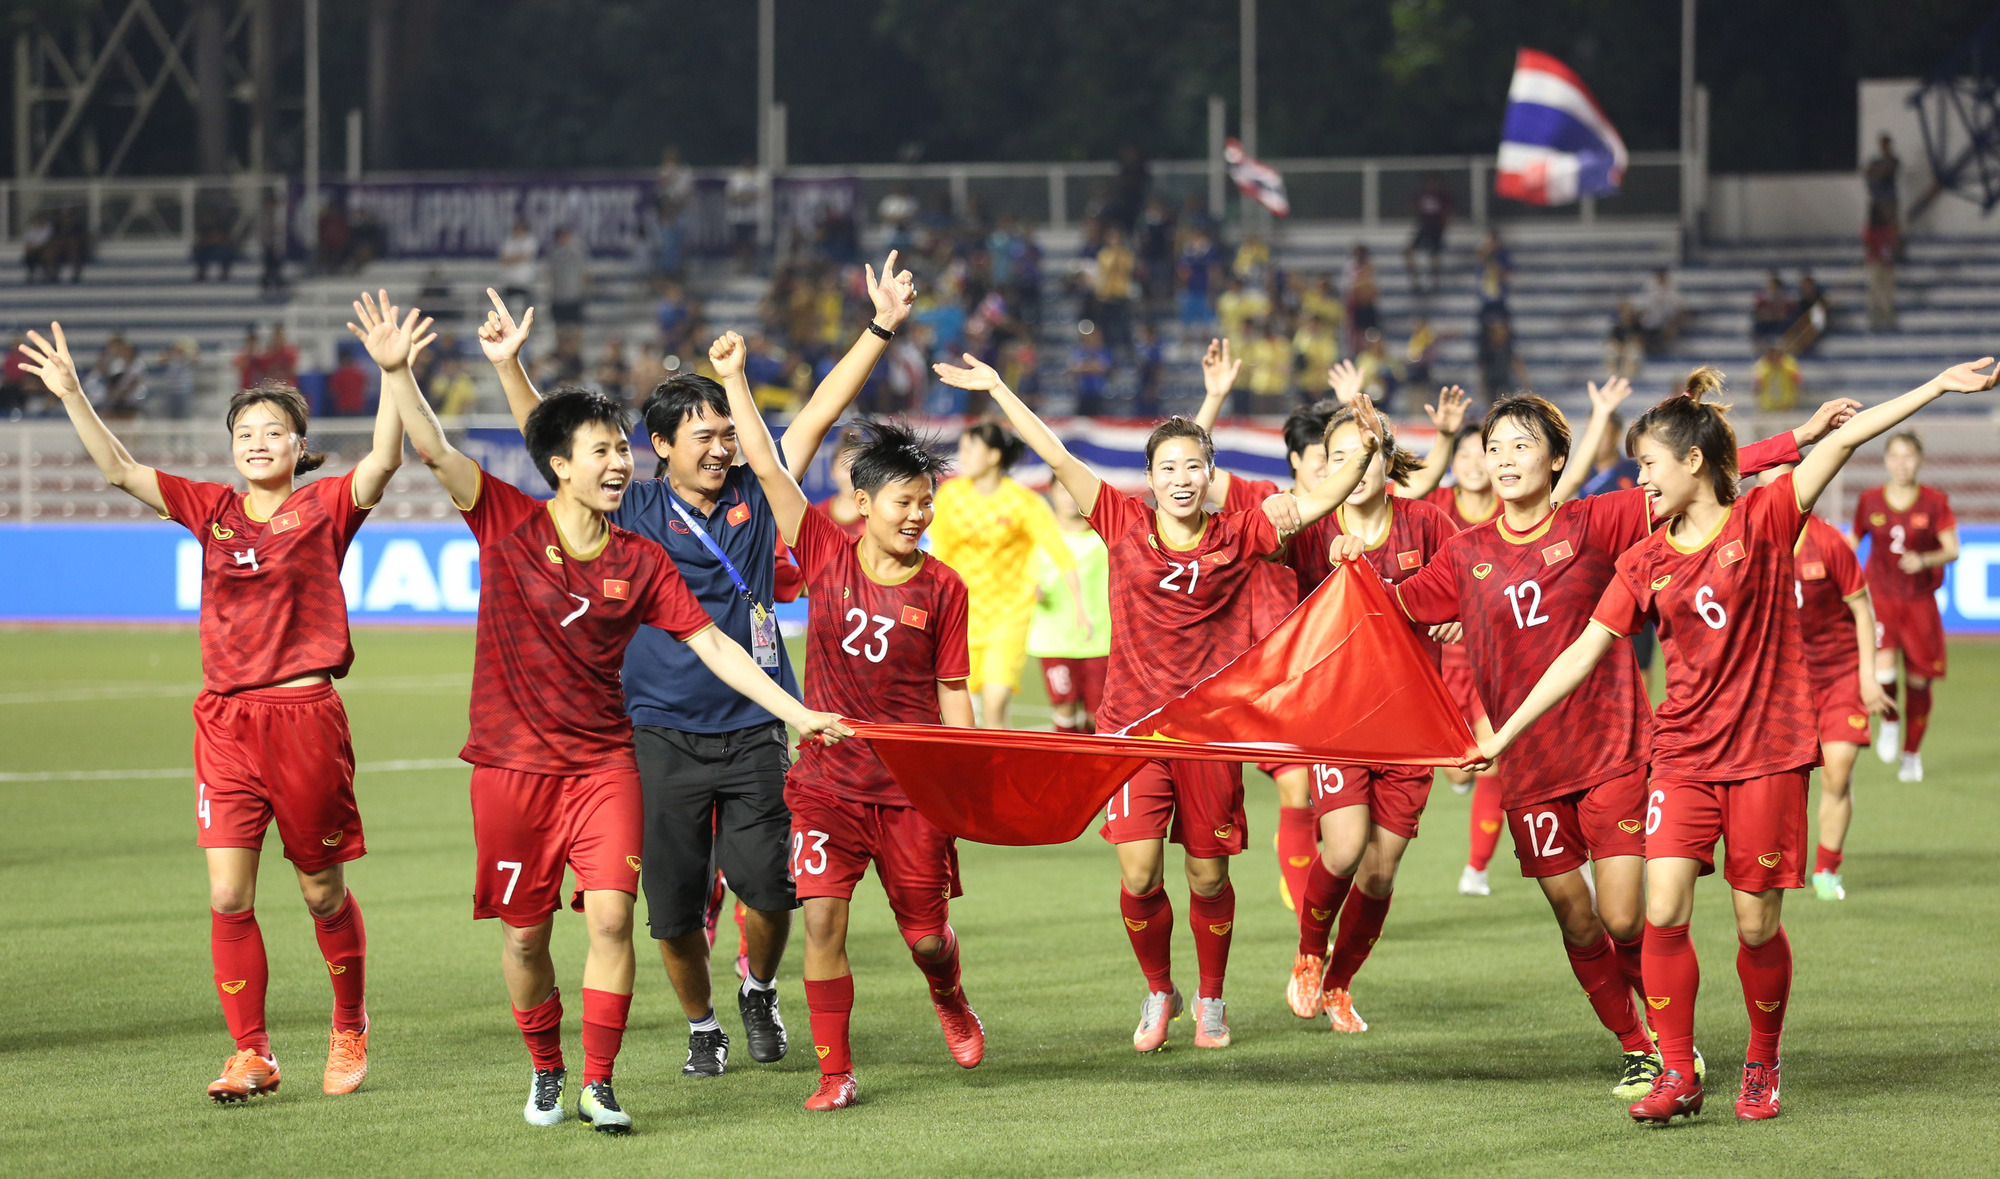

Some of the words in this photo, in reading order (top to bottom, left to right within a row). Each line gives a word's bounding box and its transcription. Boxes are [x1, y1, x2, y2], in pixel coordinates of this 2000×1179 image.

[234, 548, 259, 571] 4
[1889, 524, 1906, 554] 2
[1158, 560, 1201, 595] 21
[560, 592, 590, 628] 7
[1503, 580, 1550, 630] 12
[1695, 585, 1727, 630] 6
[841, 607, 896, 663] 23
[1312, 763, 1345, 800] 15
[198, 783, 211, 829] 4
[1645, 789, 1666, 835] 6
[794, 829, 830, 877] 23
[1523, 811, 1565, 858] 12
[497, 861, 522, 905] 7
